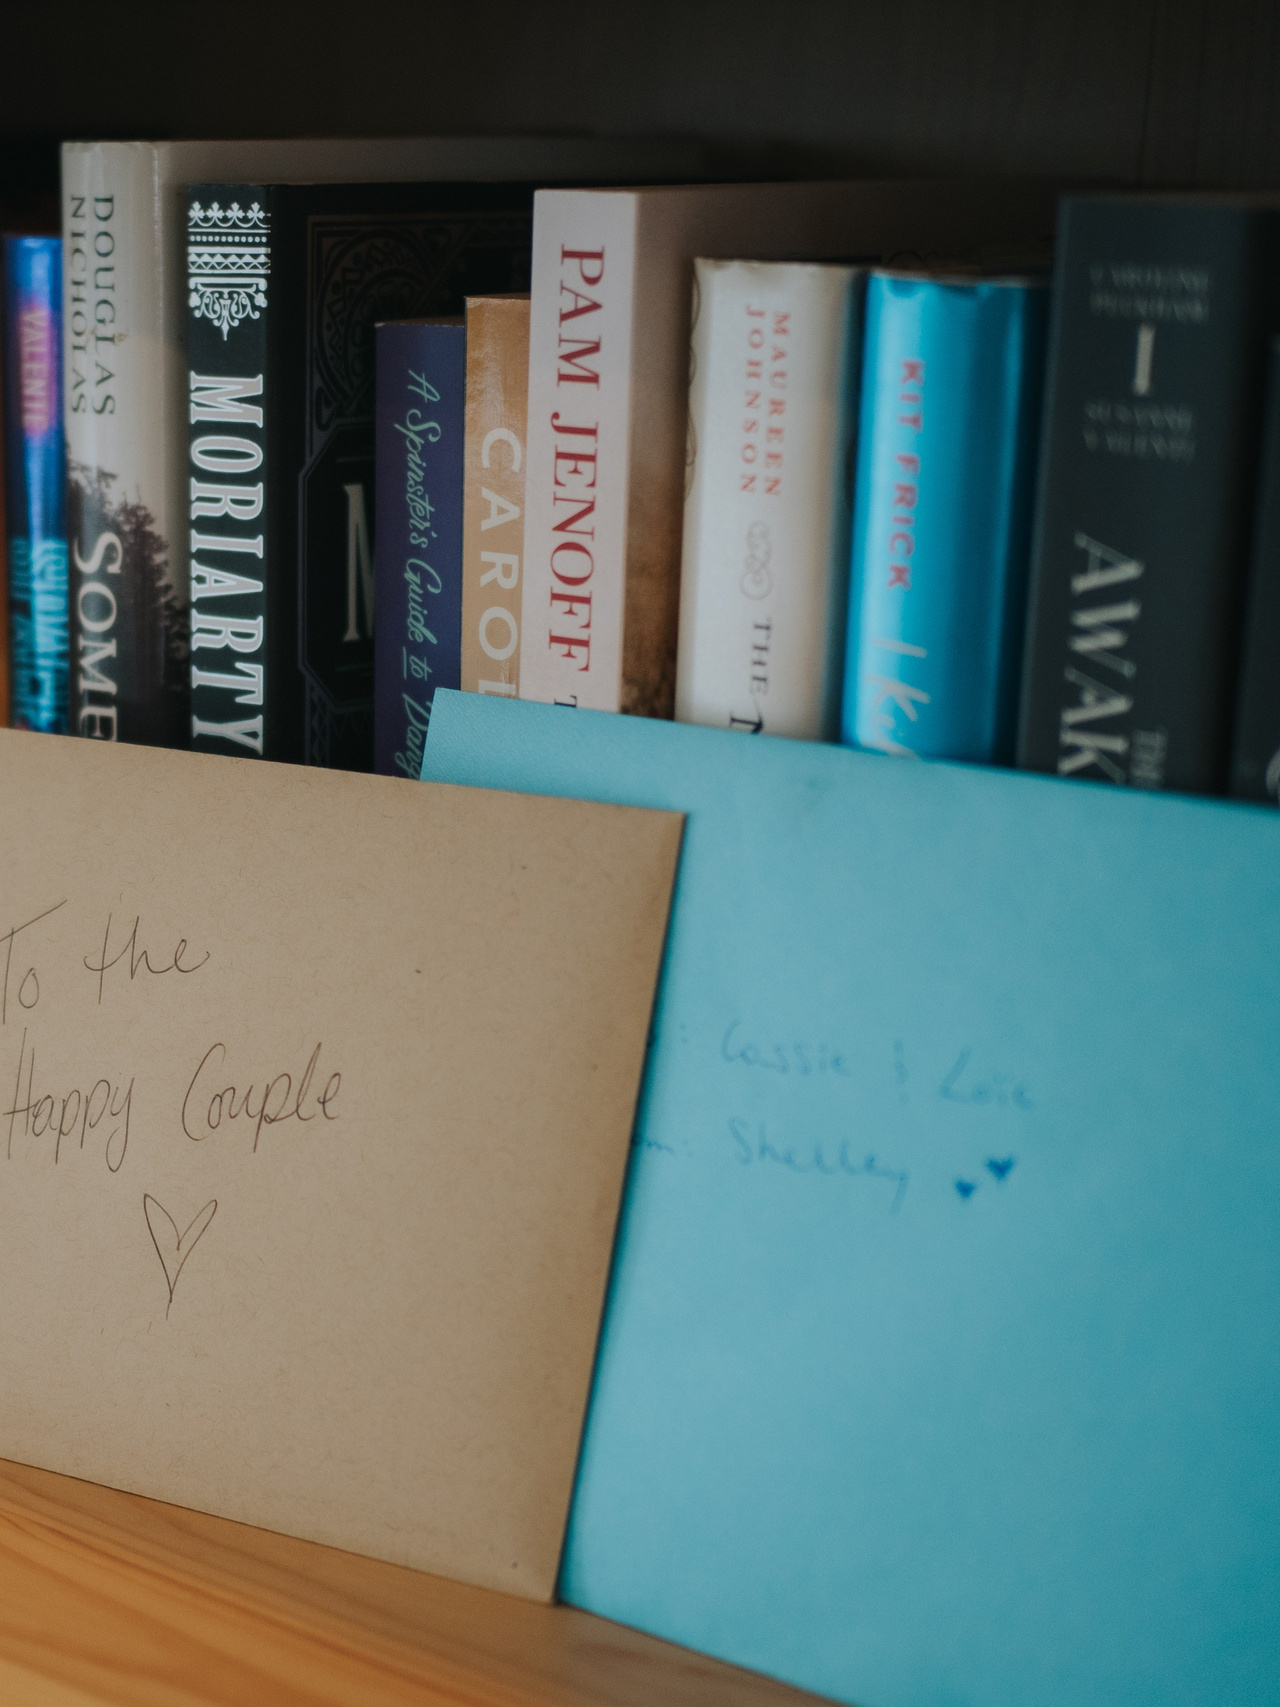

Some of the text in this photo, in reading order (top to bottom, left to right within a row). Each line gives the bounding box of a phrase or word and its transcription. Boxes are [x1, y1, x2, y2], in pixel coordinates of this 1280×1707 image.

[69, 197, 88, 415] NICHOLAS
[93, 196, 117, 415] DOUGLAS
[557, 245, 604, 390] PAM
[408, 370, 441, 403] A
[740, 305, 765, 494] JOHNSON
[764, 311, 791, 497] MAUREEN
[395, 409, 441, 547] Spinster's
[548, 411, 599, 673] JENOFF
[887, 359, 924, 590] KIT FRICK
[190, 371, 264, 756] MORIARTY
[403, 558, 442, 644] Guide
[406, 651, 430, 680] to
[750, 617, 772, 696] THE
[84, 912, 210, 1005] the
[3, 1027, 341, 1173] Happy Couple
